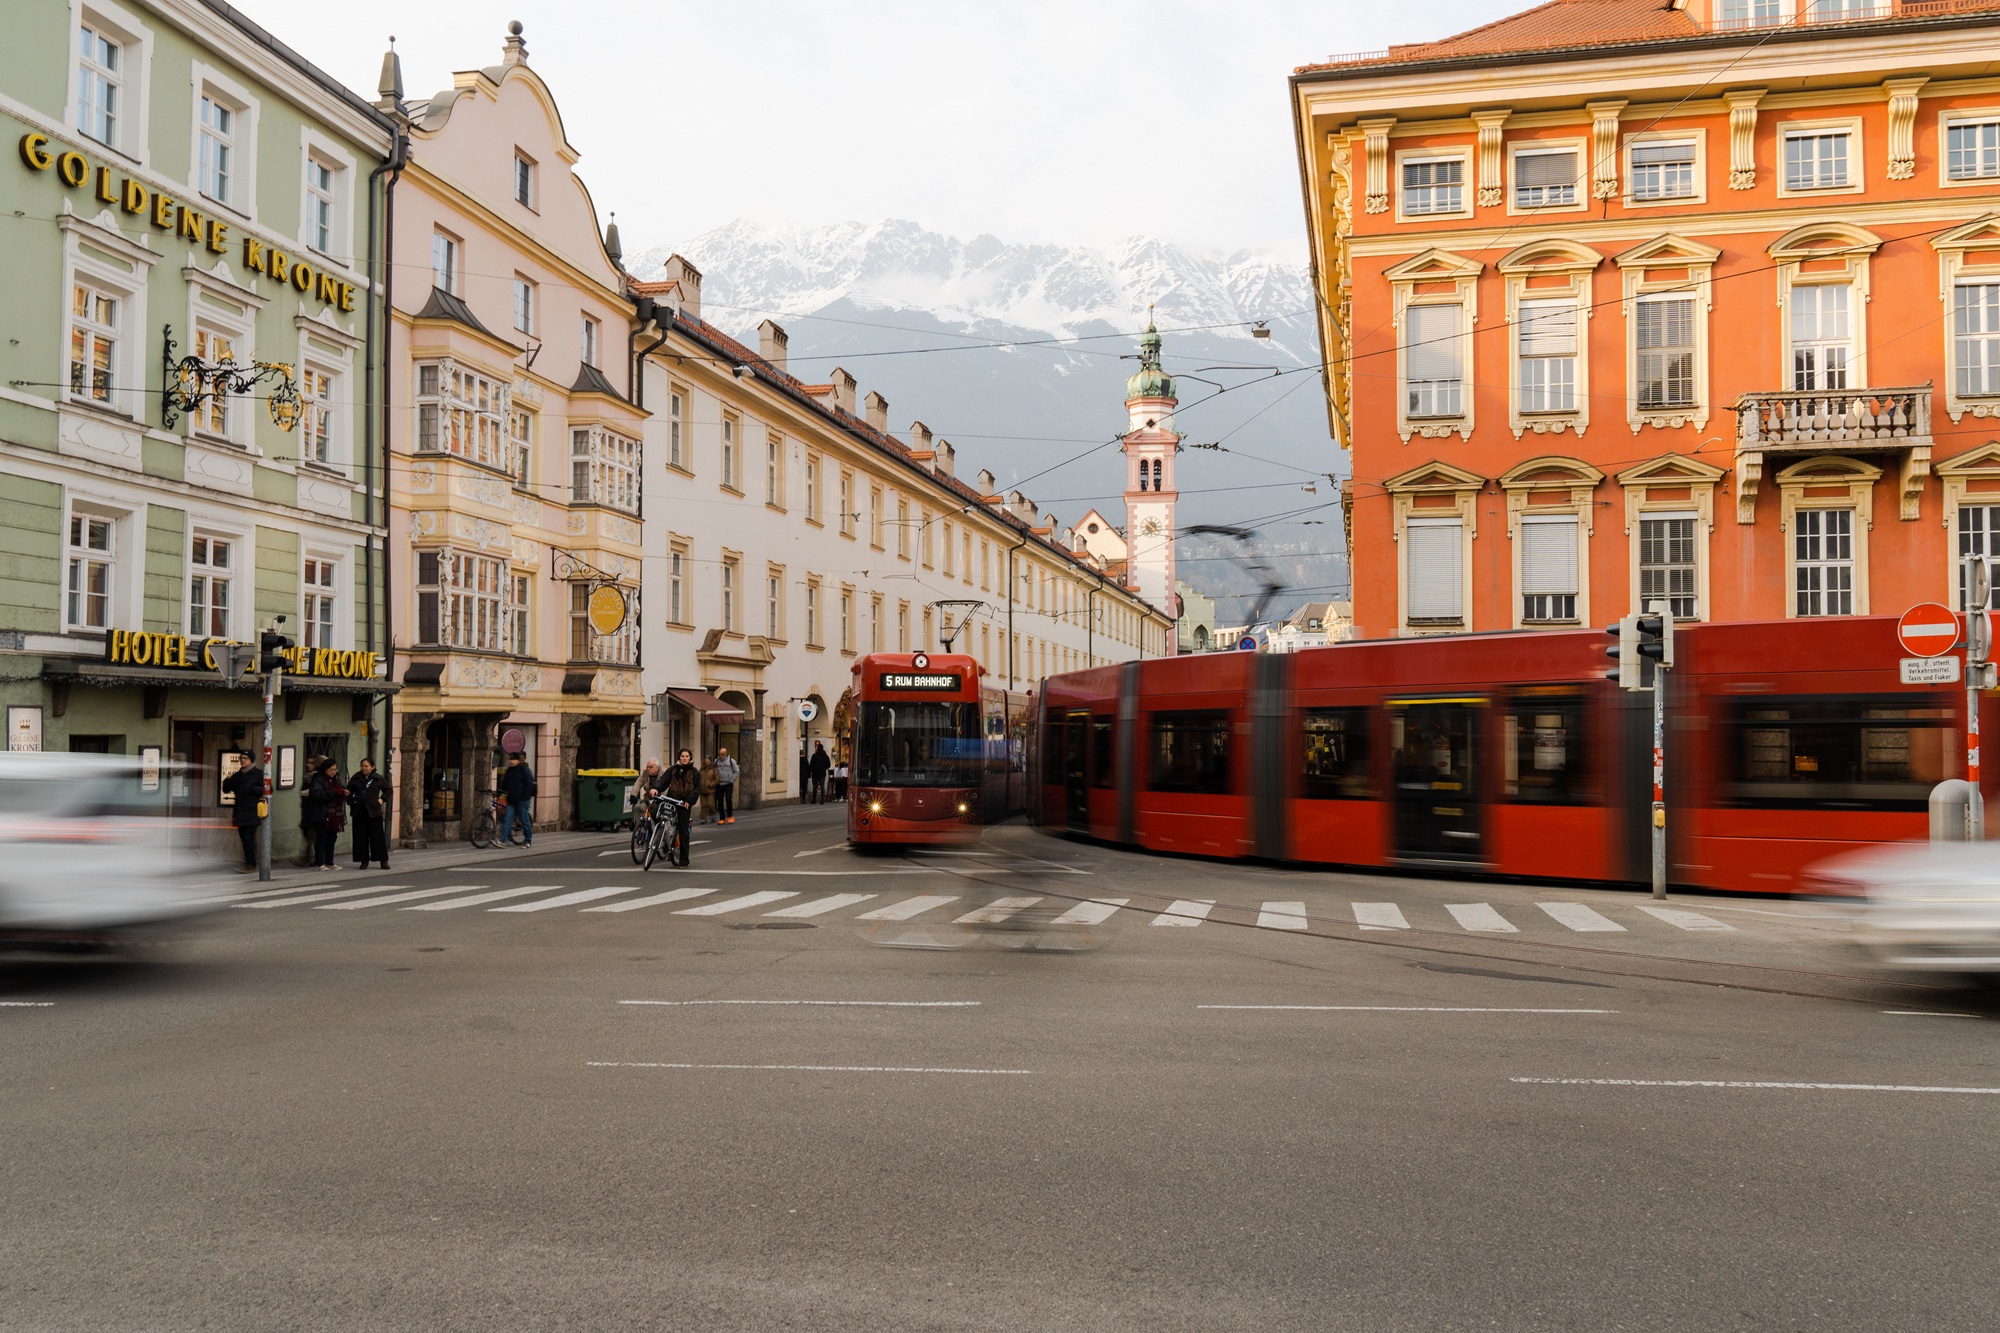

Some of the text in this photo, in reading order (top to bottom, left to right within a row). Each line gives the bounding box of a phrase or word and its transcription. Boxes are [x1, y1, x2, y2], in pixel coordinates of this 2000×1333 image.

[19, 133, 356, 312] GOLDENE KRONE
[107, 629, 193, 668] HOTEL
[313, 648, 380, 679] KRONE
[886, 676, 952, 687] 5 RUM BAHNHOF
[11, 744, 40, 752] KRONE
